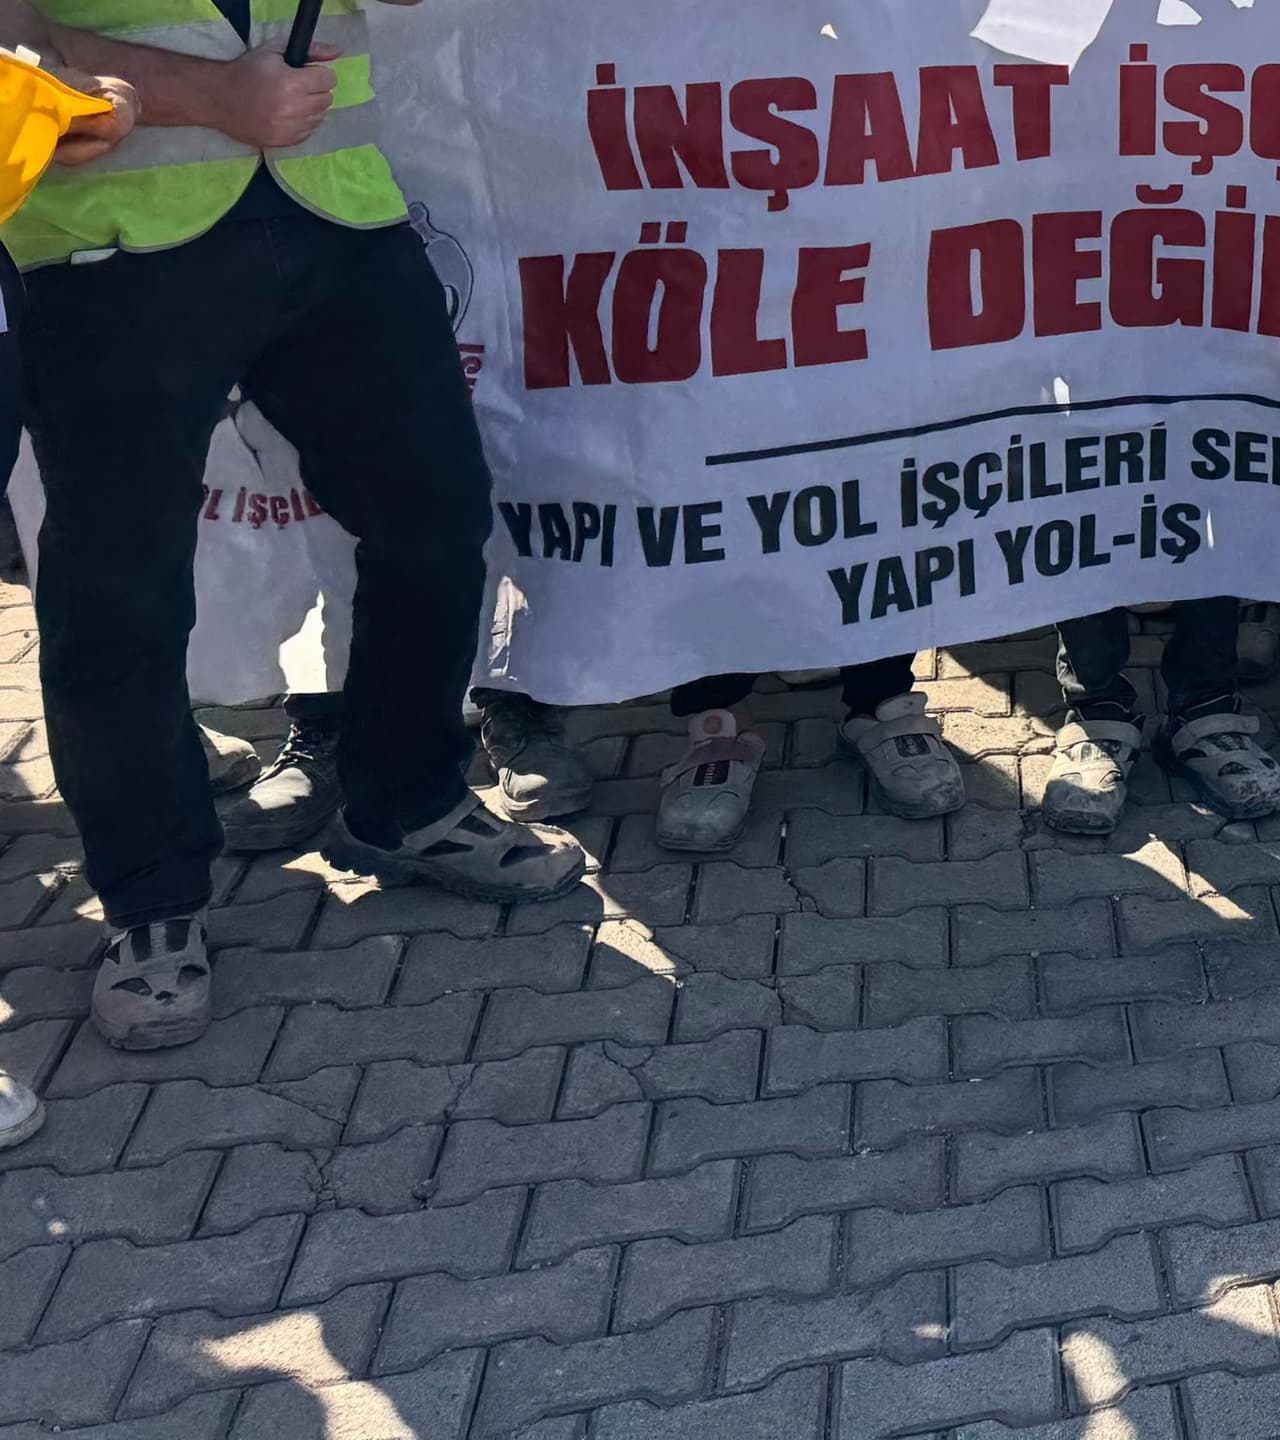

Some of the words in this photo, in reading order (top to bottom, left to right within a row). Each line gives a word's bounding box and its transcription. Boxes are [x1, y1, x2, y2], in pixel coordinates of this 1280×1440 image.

[587, 62, 1070, 212] İNŞAAT
[518, 220, 871, 391] KÖLE
[232, 486, 322, 530] İŞÇİL
[497, 501, 618, 567] YAPI
[636, 501, 726, 568] VE
[746, 479, 878, 554] YOL
[900, 421, 1168, 530] İŞÇİLERİ
[826, 538, 976, 626] YAPI
[994, 493, 1201, 586] YOL-İŞ
